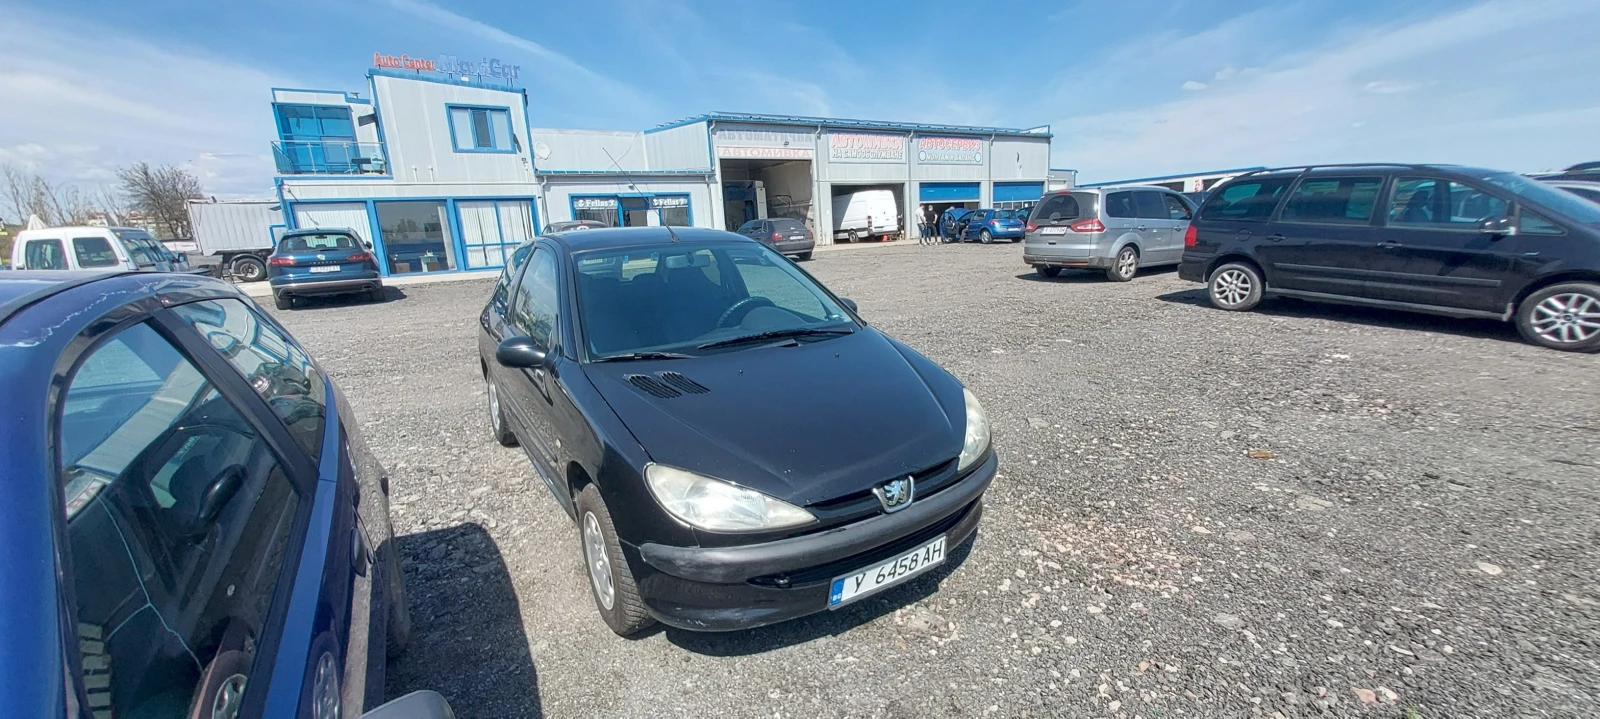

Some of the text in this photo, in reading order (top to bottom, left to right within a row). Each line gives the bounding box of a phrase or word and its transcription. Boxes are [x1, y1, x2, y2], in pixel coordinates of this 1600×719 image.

[374, 52, 400, 67] Auto
[401, 54, 436, 70] Center
[722, 148, 810, 158] АВТОМИВКА
[832, 149, 842, 158] НА
[585, 199, 608, 207] Fellas
[660, 198, 681, 206] Fellas
[875, 553, 919, 585] 6458
